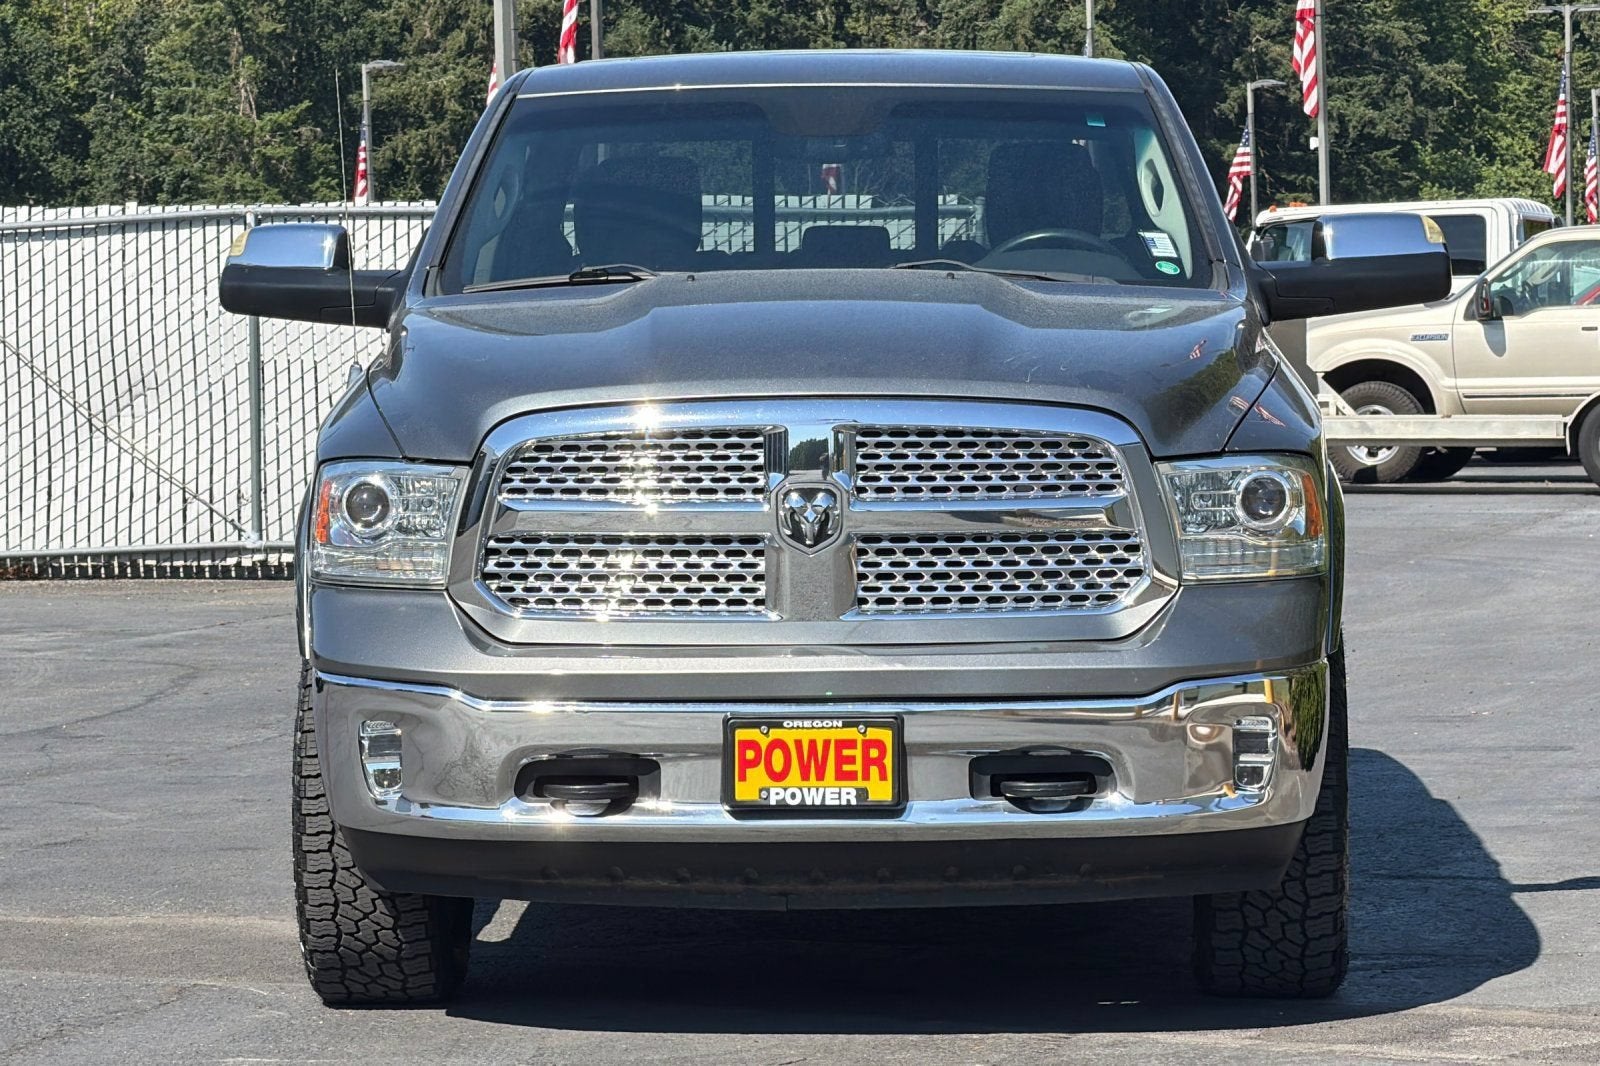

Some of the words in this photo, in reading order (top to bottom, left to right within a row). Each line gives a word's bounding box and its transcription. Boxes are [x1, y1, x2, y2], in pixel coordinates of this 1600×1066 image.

[783, 720, 843, 728] OREGON
[737, 738, 888, 782] POWER
[769, 787, 857, 806] POWER
